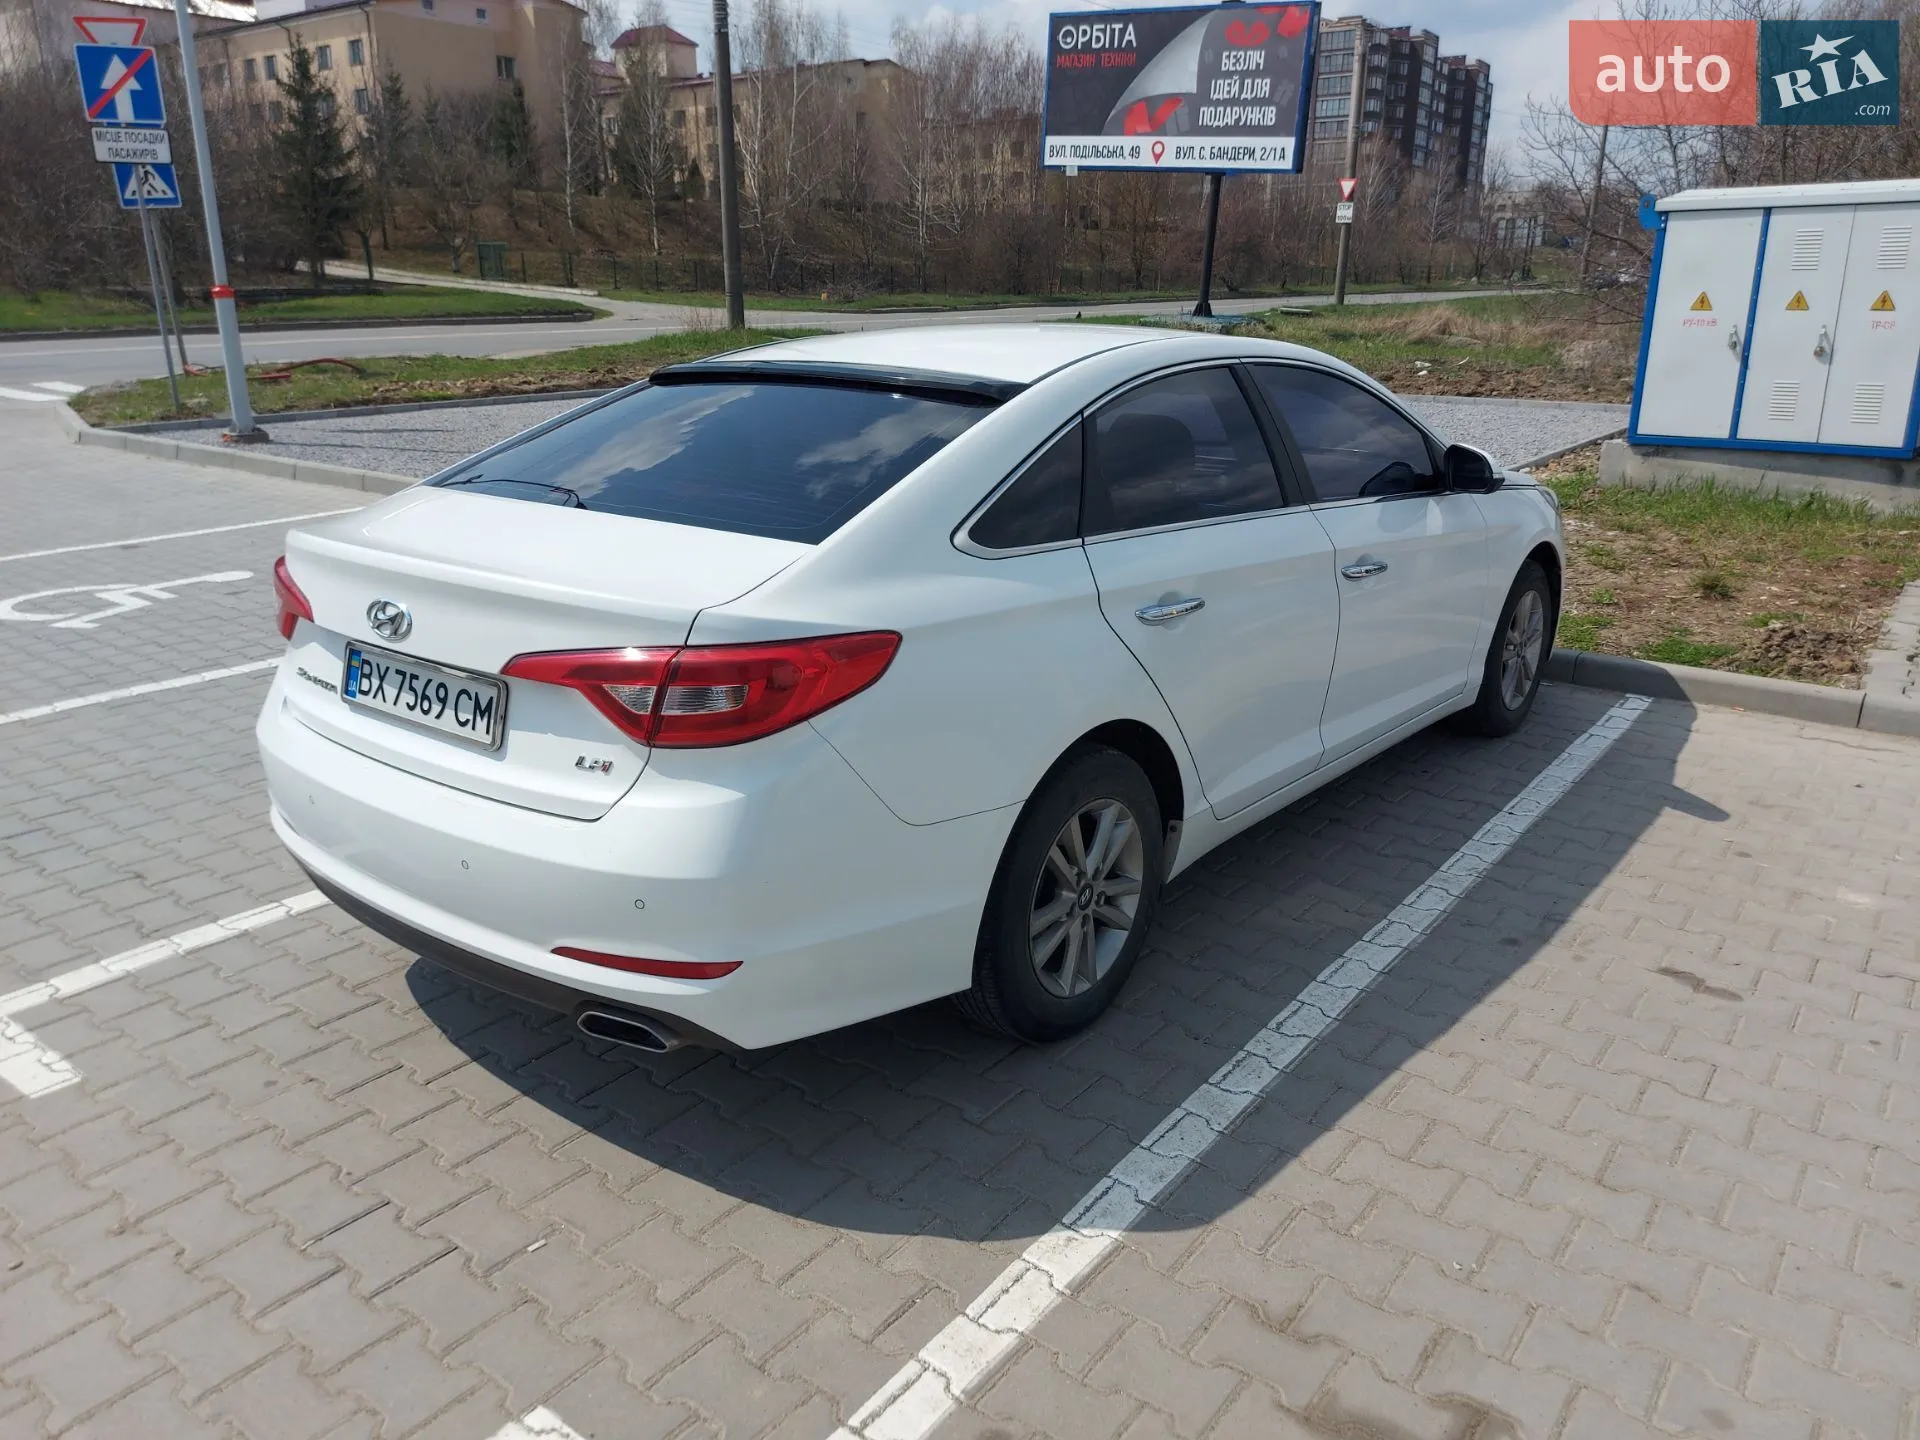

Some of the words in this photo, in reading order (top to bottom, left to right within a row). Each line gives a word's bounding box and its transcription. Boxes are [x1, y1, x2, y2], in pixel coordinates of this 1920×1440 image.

[1058, 23, 1137, 50] ОРБІТА
[1056, 53, 1096, 68] МАГАЗИН
[1100, 51, 1137, 67] ТЕХНІКИ
[1221, 50, 1265, 72] БЕЗЛІЧ
[1210, 75, 1240, 101] ІДЕЙ
[1240, 78, 1271, 101] ДЛЯ
[1198, 105, 1277, 128] ПОДАРУНКІВ
[95, 130, 122, 143] МІСЦЕ
[124, 132, 166, 145] ПОСАДКИ
[107, 147, 159, 160] ПАСАЖИРІВ
[1049, 145, 1067, 158] ВУЛ.
[1069, 145, 1126, 160] ПОДІЛЬСЬКА,
[1128, 145, 1141, 159] 49
[1175, 146, 1196, 160] ВУЛ.
[1198, 146, 1207, 160] С.
[1209, 146, 1257, 162] БАНДЕРИ,
[359, 658, 390, 703] BX
[394, 668, 449, 720] 7569
[454, 688, 494, 735] CM
